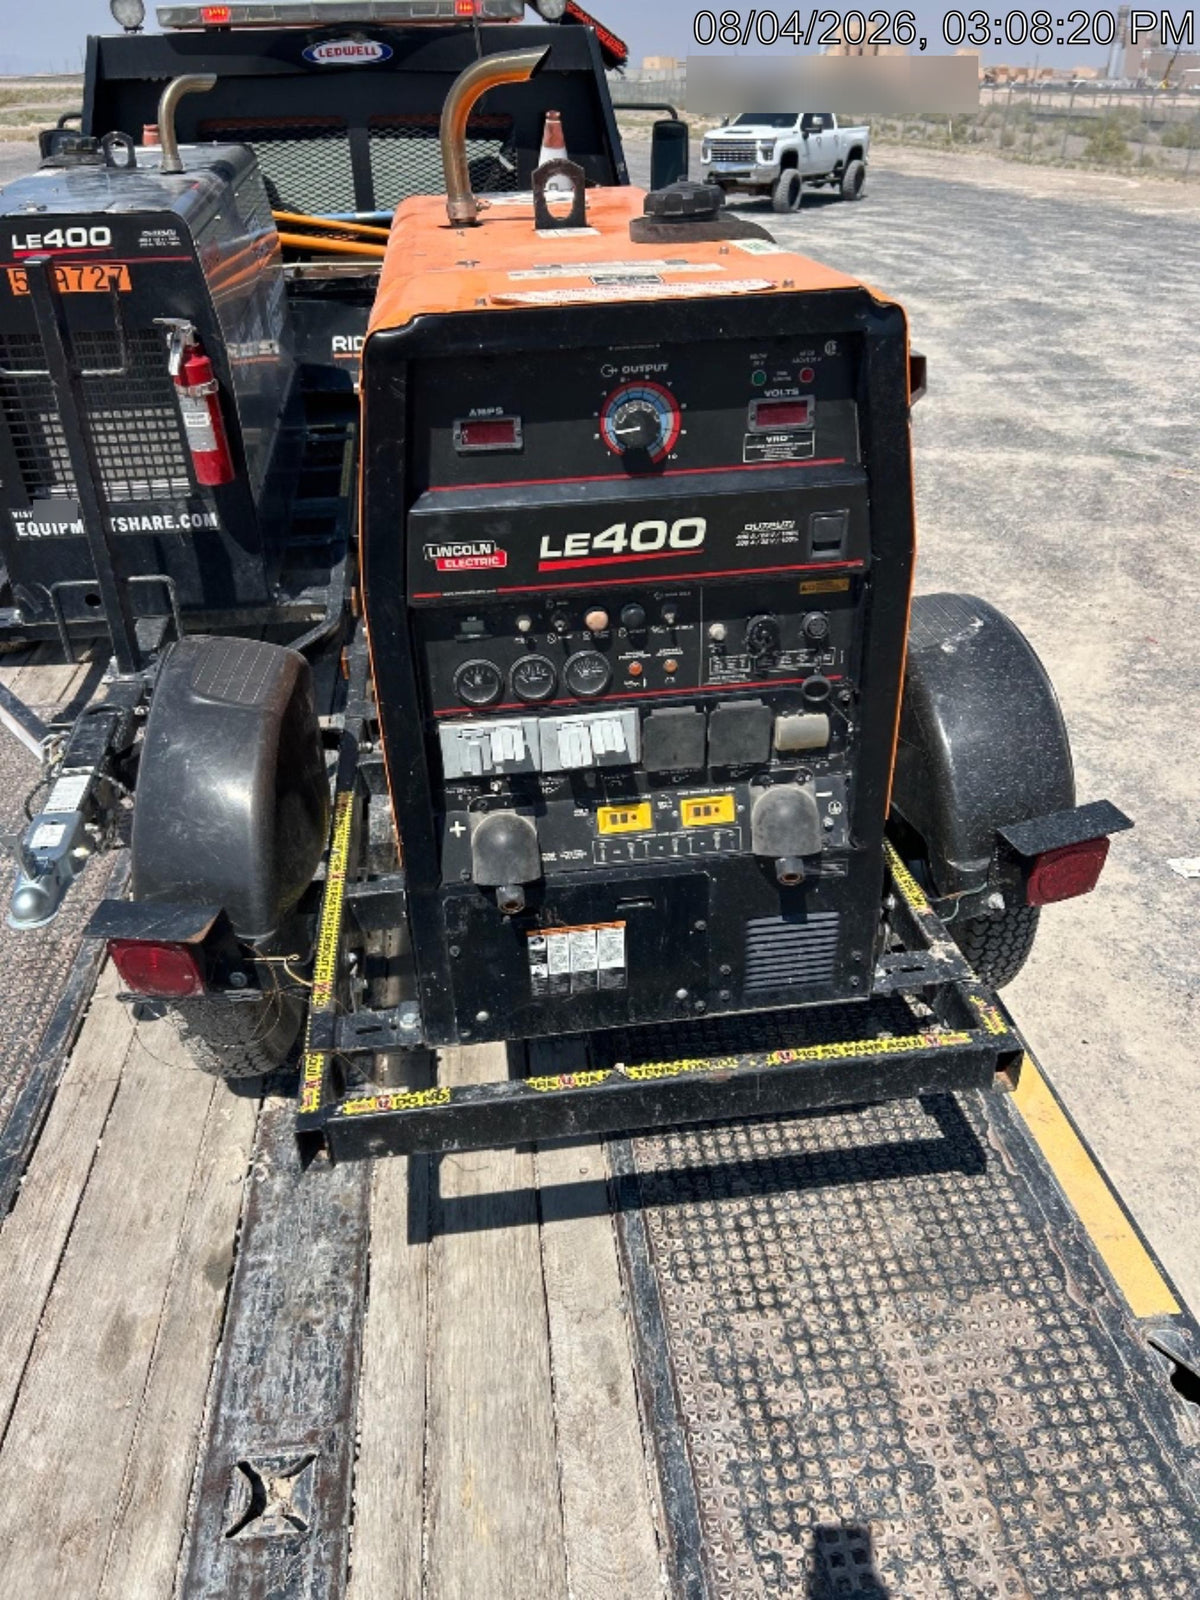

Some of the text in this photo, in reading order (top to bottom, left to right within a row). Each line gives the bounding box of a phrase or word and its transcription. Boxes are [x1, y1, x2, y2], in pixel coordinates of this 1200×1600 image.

[318, 46, 378, 58] LEDWELL
[11, 227, 112, 250] LE400
[621, 363, 669, 374] OUTPUT
[764, 388, 800, 397] VOLTS
[469, 406, 504, 417] AMPS
[15, 512, 219, 538] EQUIPMTSHARE.COM
[539, 516, 707, 559] LE400
[428, 543, 493, 558] LINCOLN
[444, 556, 501, 569] ELECTRIC
